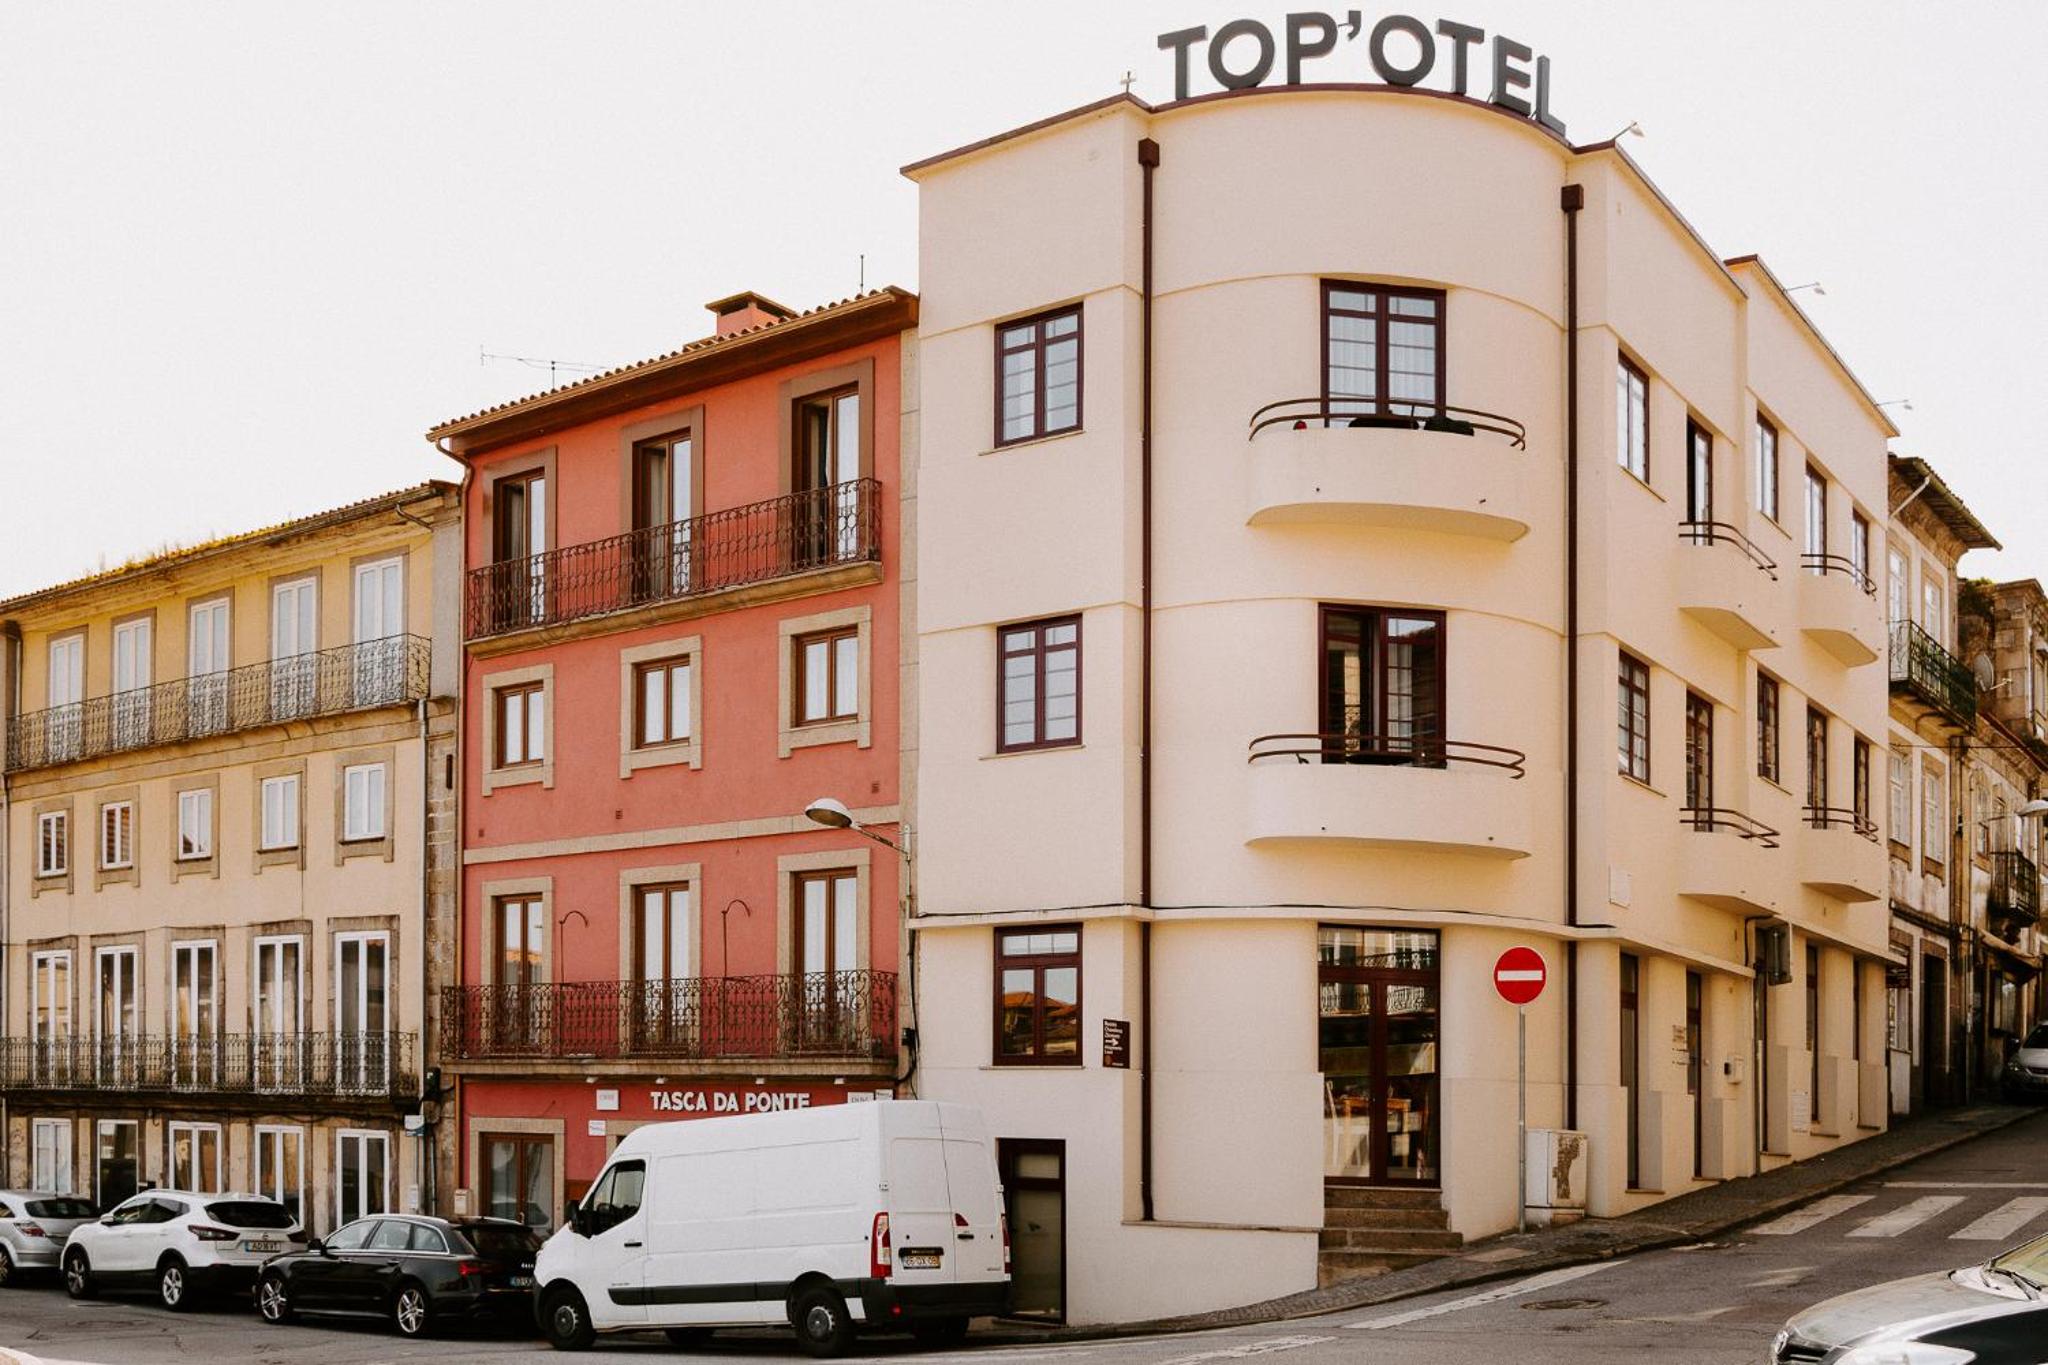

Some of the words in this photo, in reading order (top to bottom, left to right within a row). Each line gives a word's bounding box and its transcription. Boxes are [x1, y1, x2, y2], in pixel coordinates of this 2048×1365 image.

[1157, 10, 1566, 137] TOP'OTEL
[650, 1091, 708, 1111] TASCA
[713, 1092, 739, 1111] DA
[744, 1092, 810, 1112] PONTE
